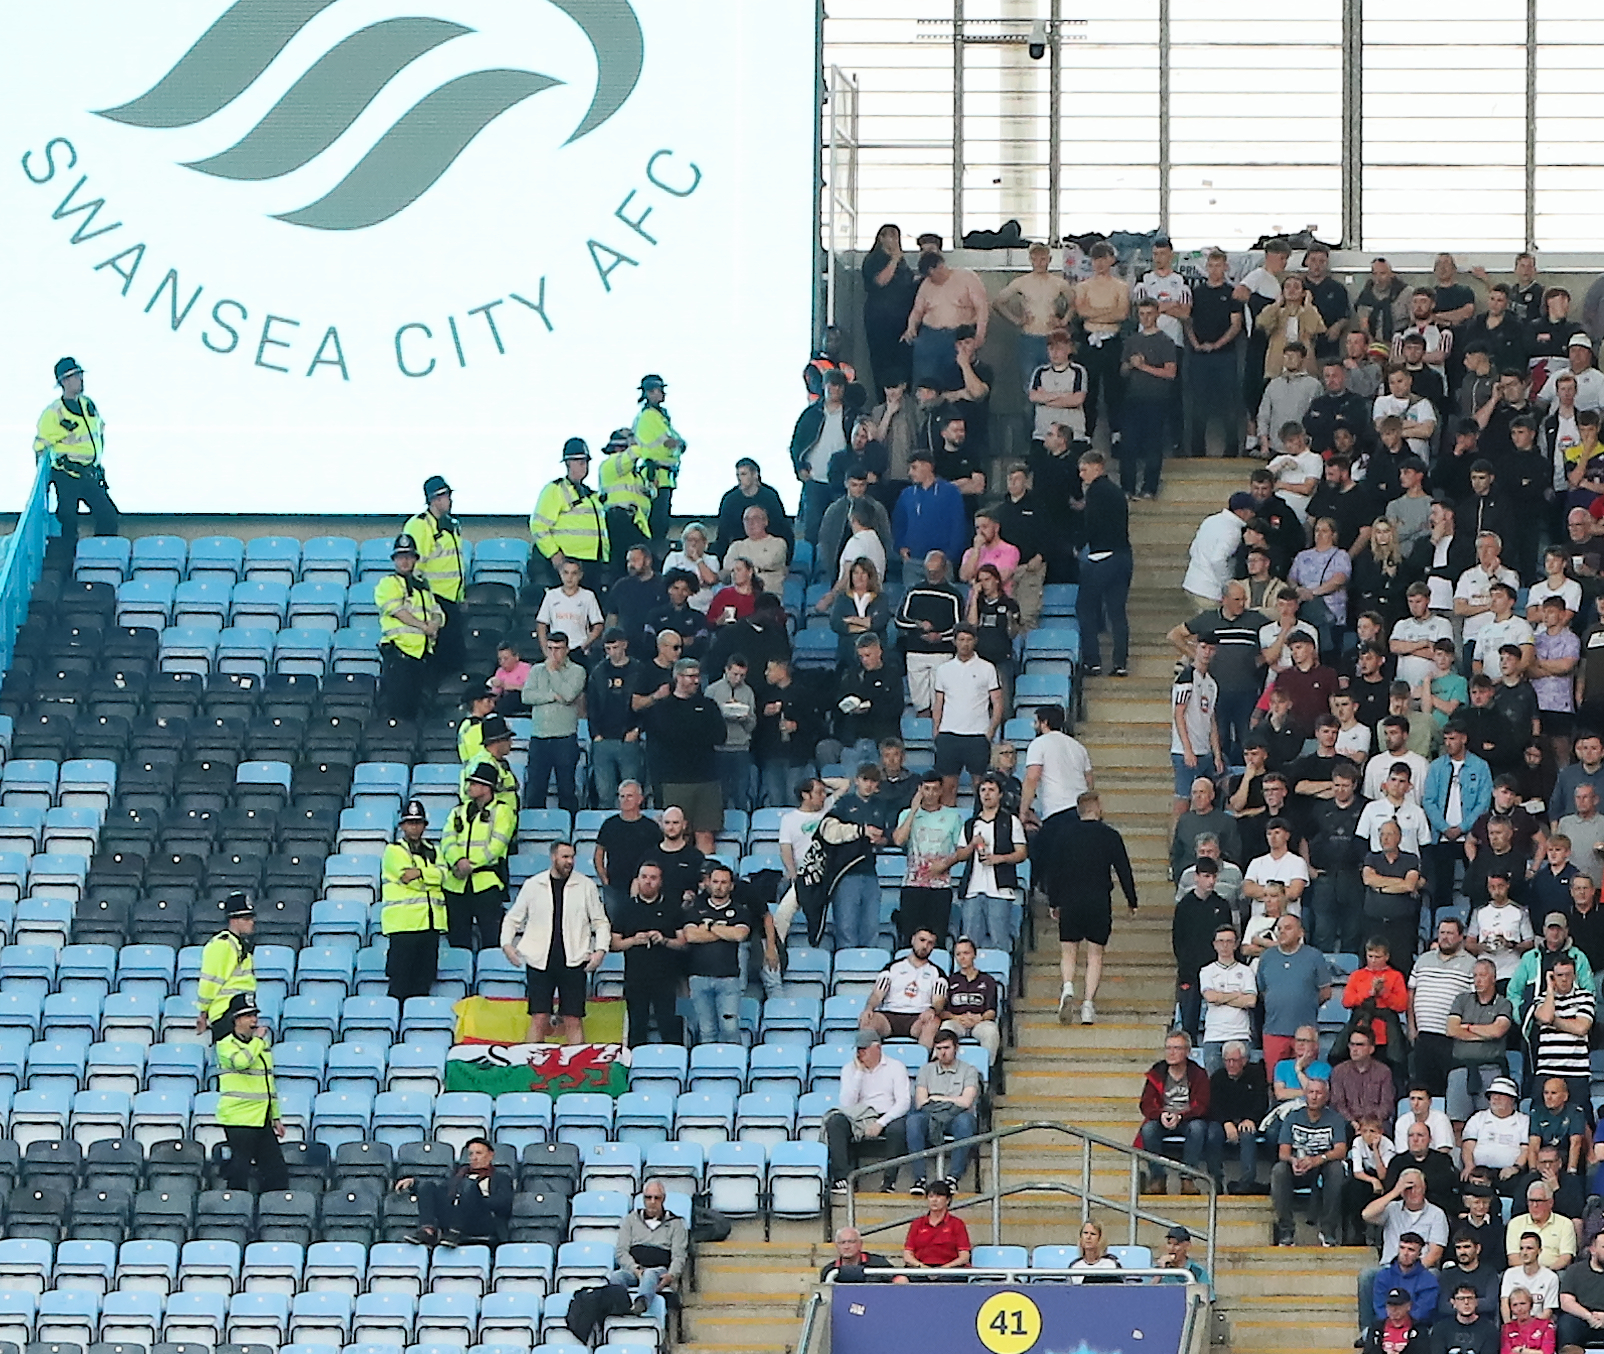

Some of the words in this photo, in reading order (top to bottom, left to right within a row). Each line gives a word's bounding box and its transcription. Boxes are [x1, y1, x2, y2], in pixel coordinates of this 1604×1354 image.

[21, 137, 351, 381] SWANSEA
[394, 277, 557, 379] CITY
[587, 148, 704, 292] AFC
[990, 1310, 1028, 1336] 41
